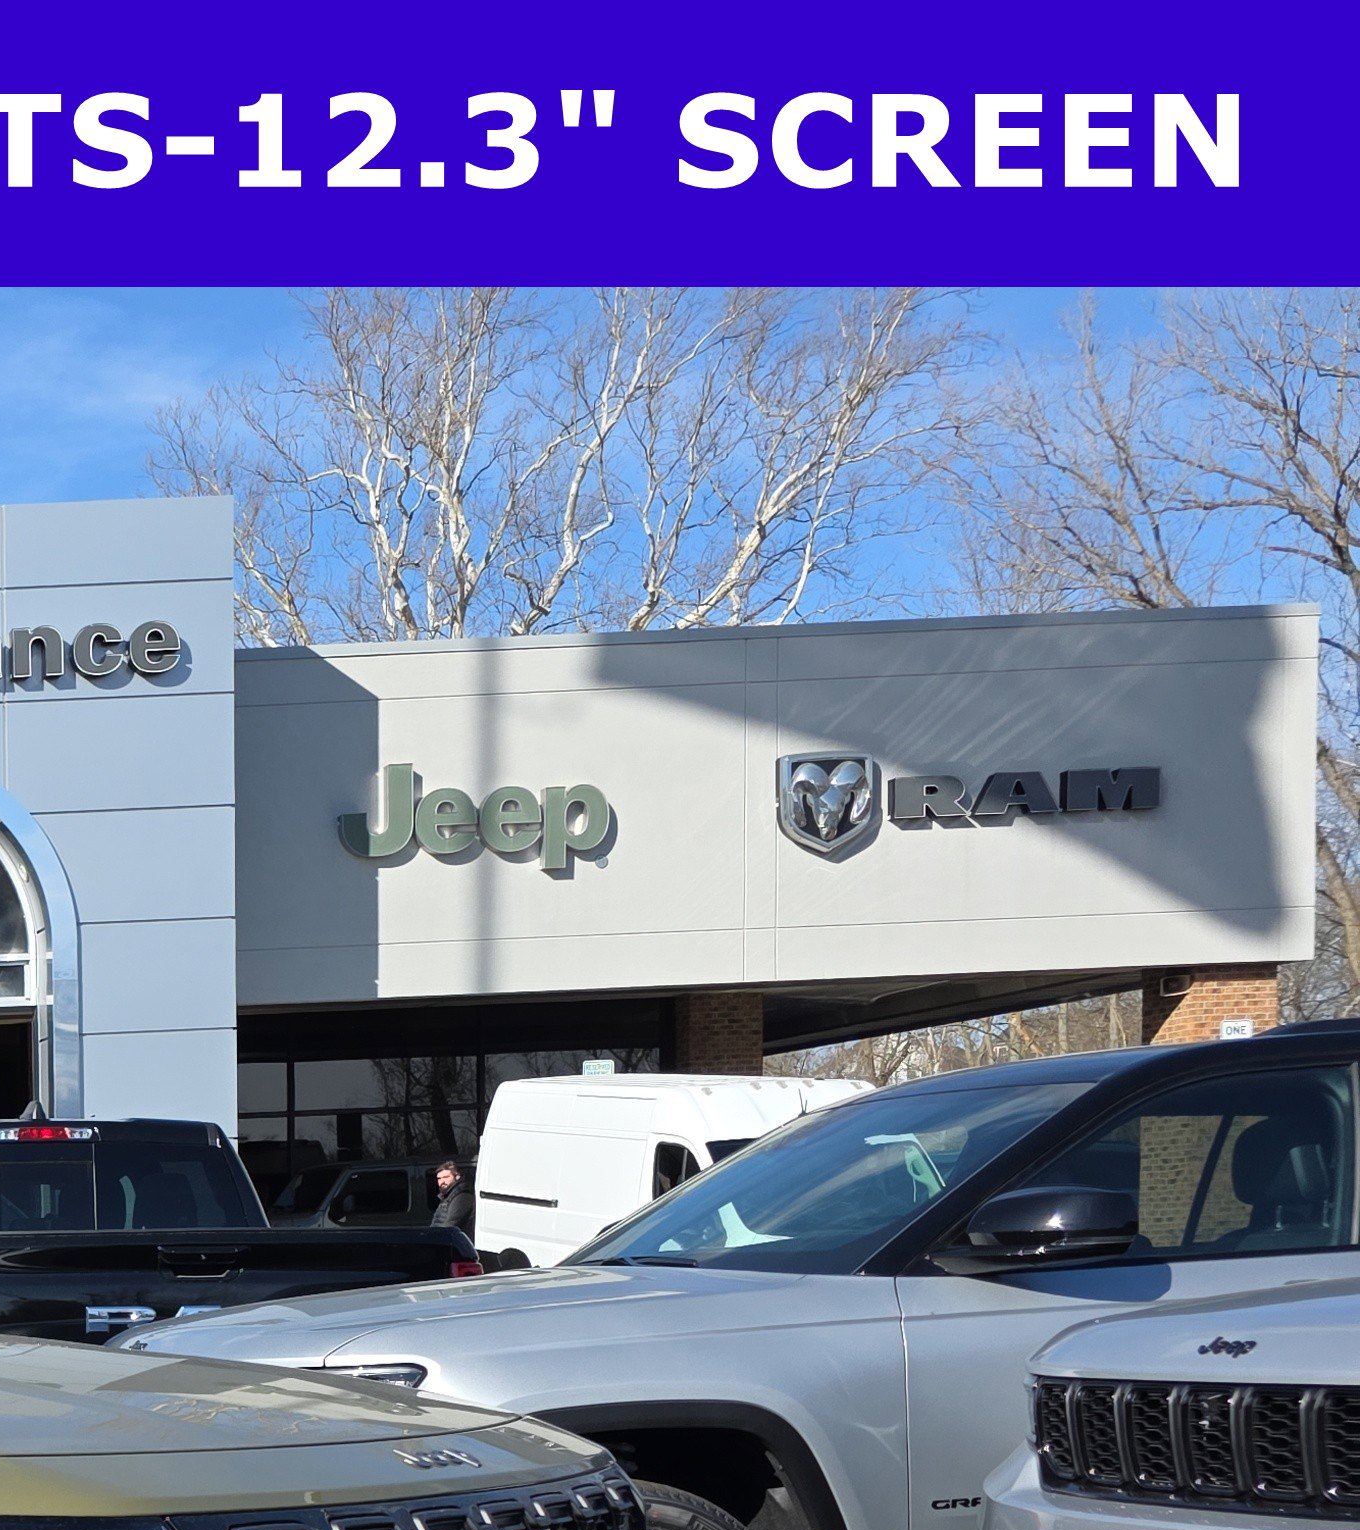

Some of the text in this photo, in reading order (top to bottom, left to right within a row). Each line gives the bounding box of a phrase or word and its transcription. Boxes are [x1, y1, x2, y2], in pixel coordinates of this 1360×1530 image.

[887, 766, 1162, 821] RAM
[341, 763, 610, 869] Jeep
[1225, 1025, 1247, 1036] ONE
[1197, 1336, 1257, 1358] Jeep
